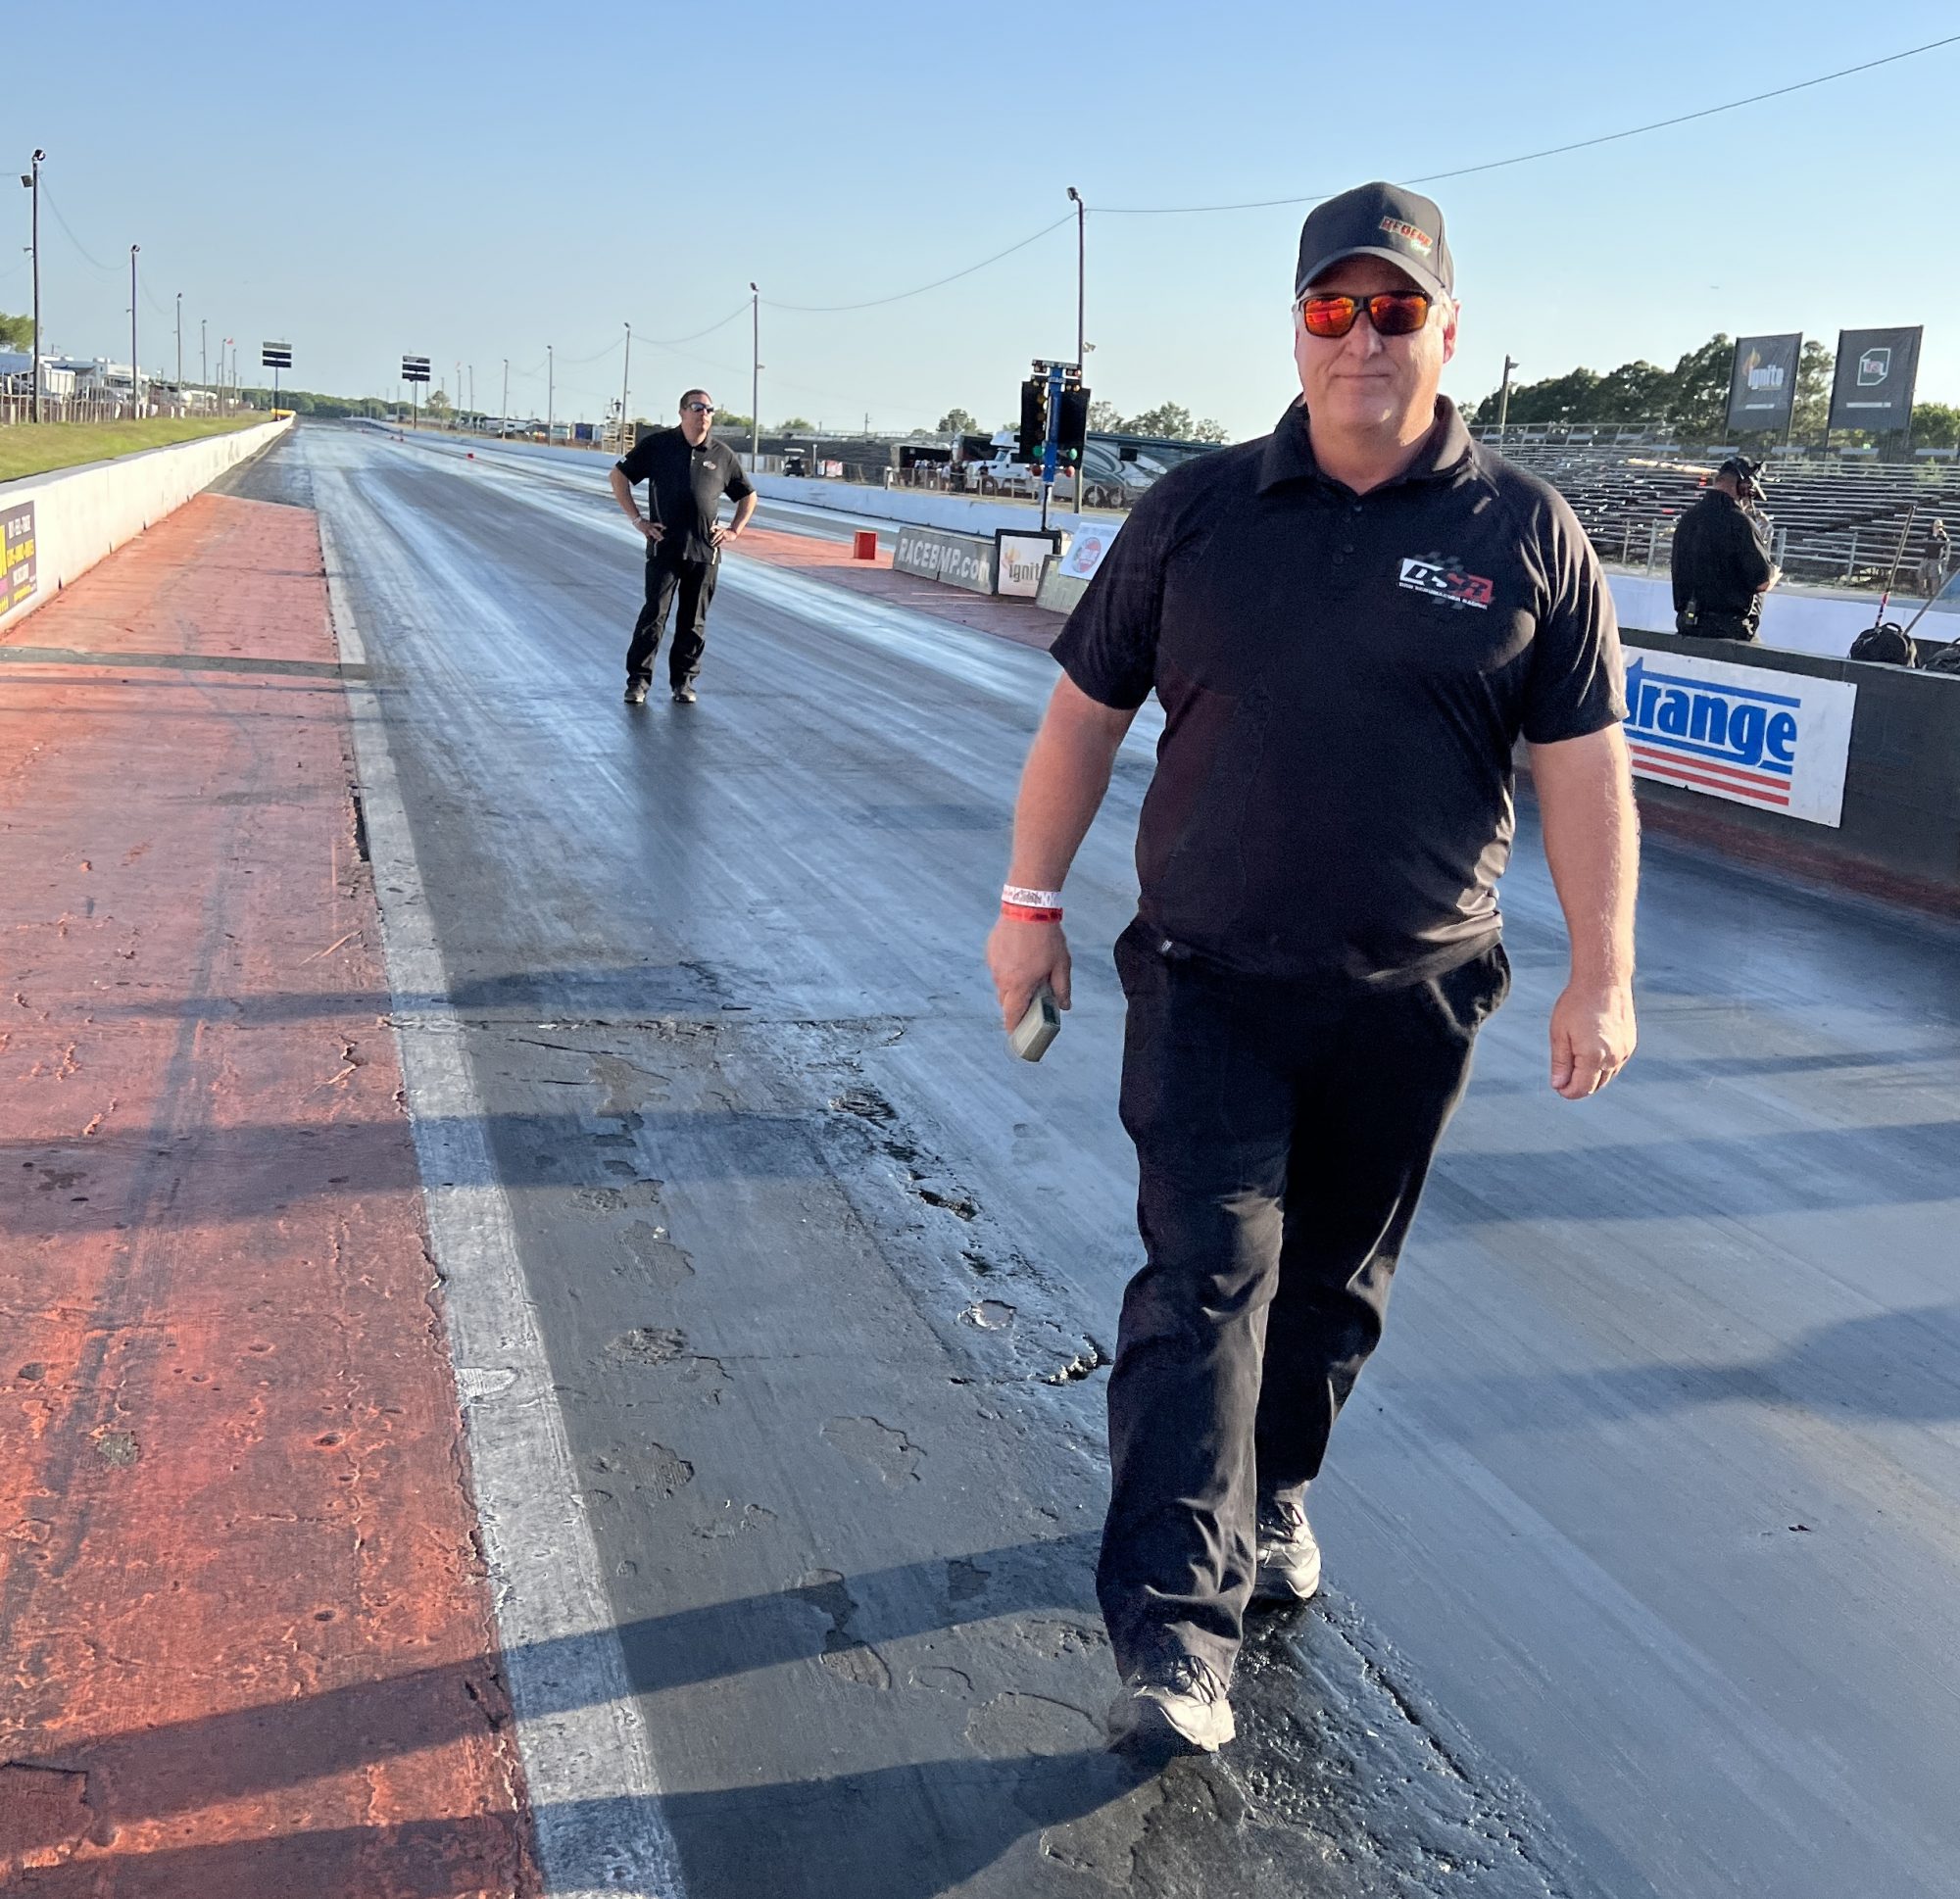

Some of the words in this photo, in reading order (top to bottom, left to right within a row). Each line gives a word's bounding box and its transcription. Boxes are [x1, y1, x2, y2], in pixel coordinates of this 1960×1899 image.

[899, 538, 990, 581] RACEBMP.com
[1009, 561, 1040, 582] ignit
[1623, 657, 1797, 766] trange
